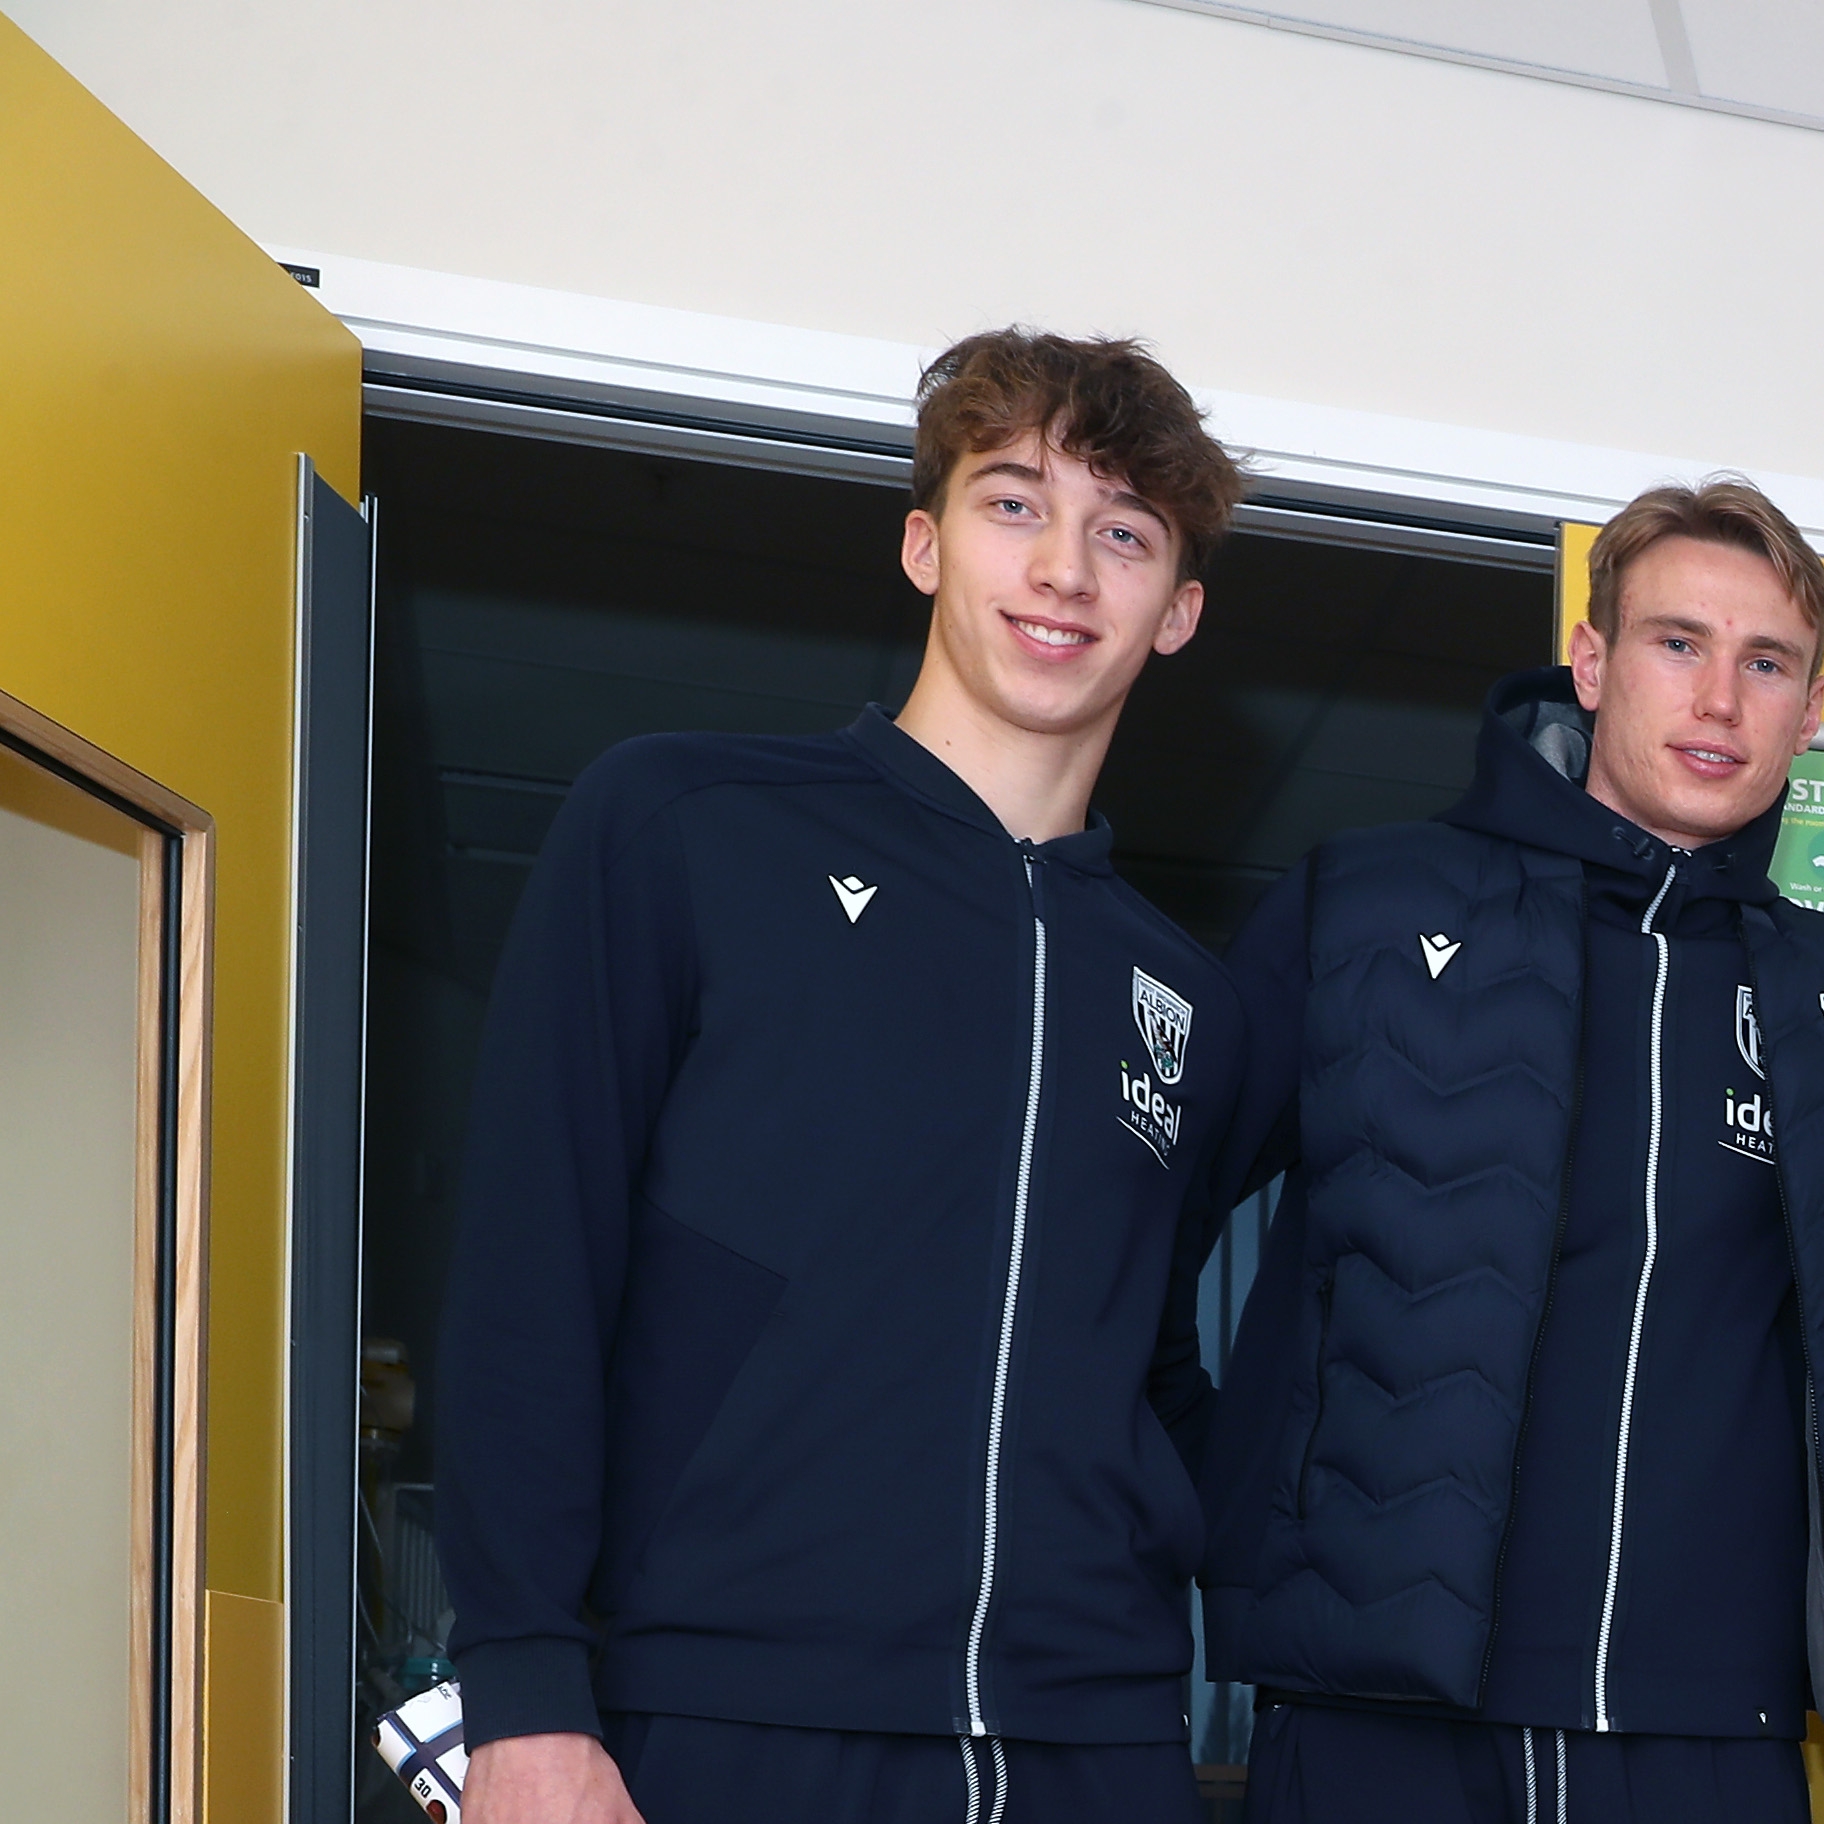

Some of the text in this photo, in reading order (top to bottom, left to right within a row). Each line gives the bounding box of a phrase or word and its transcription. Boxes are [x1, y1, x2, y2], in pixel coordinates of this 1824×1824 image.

[1790, 882, 1812, 892] Wash
[1140, 989, 1186, 1031] ALBION
[1120, 1060, 1182, 1145] ideal
[414, 1777, 432, 1798] 30
